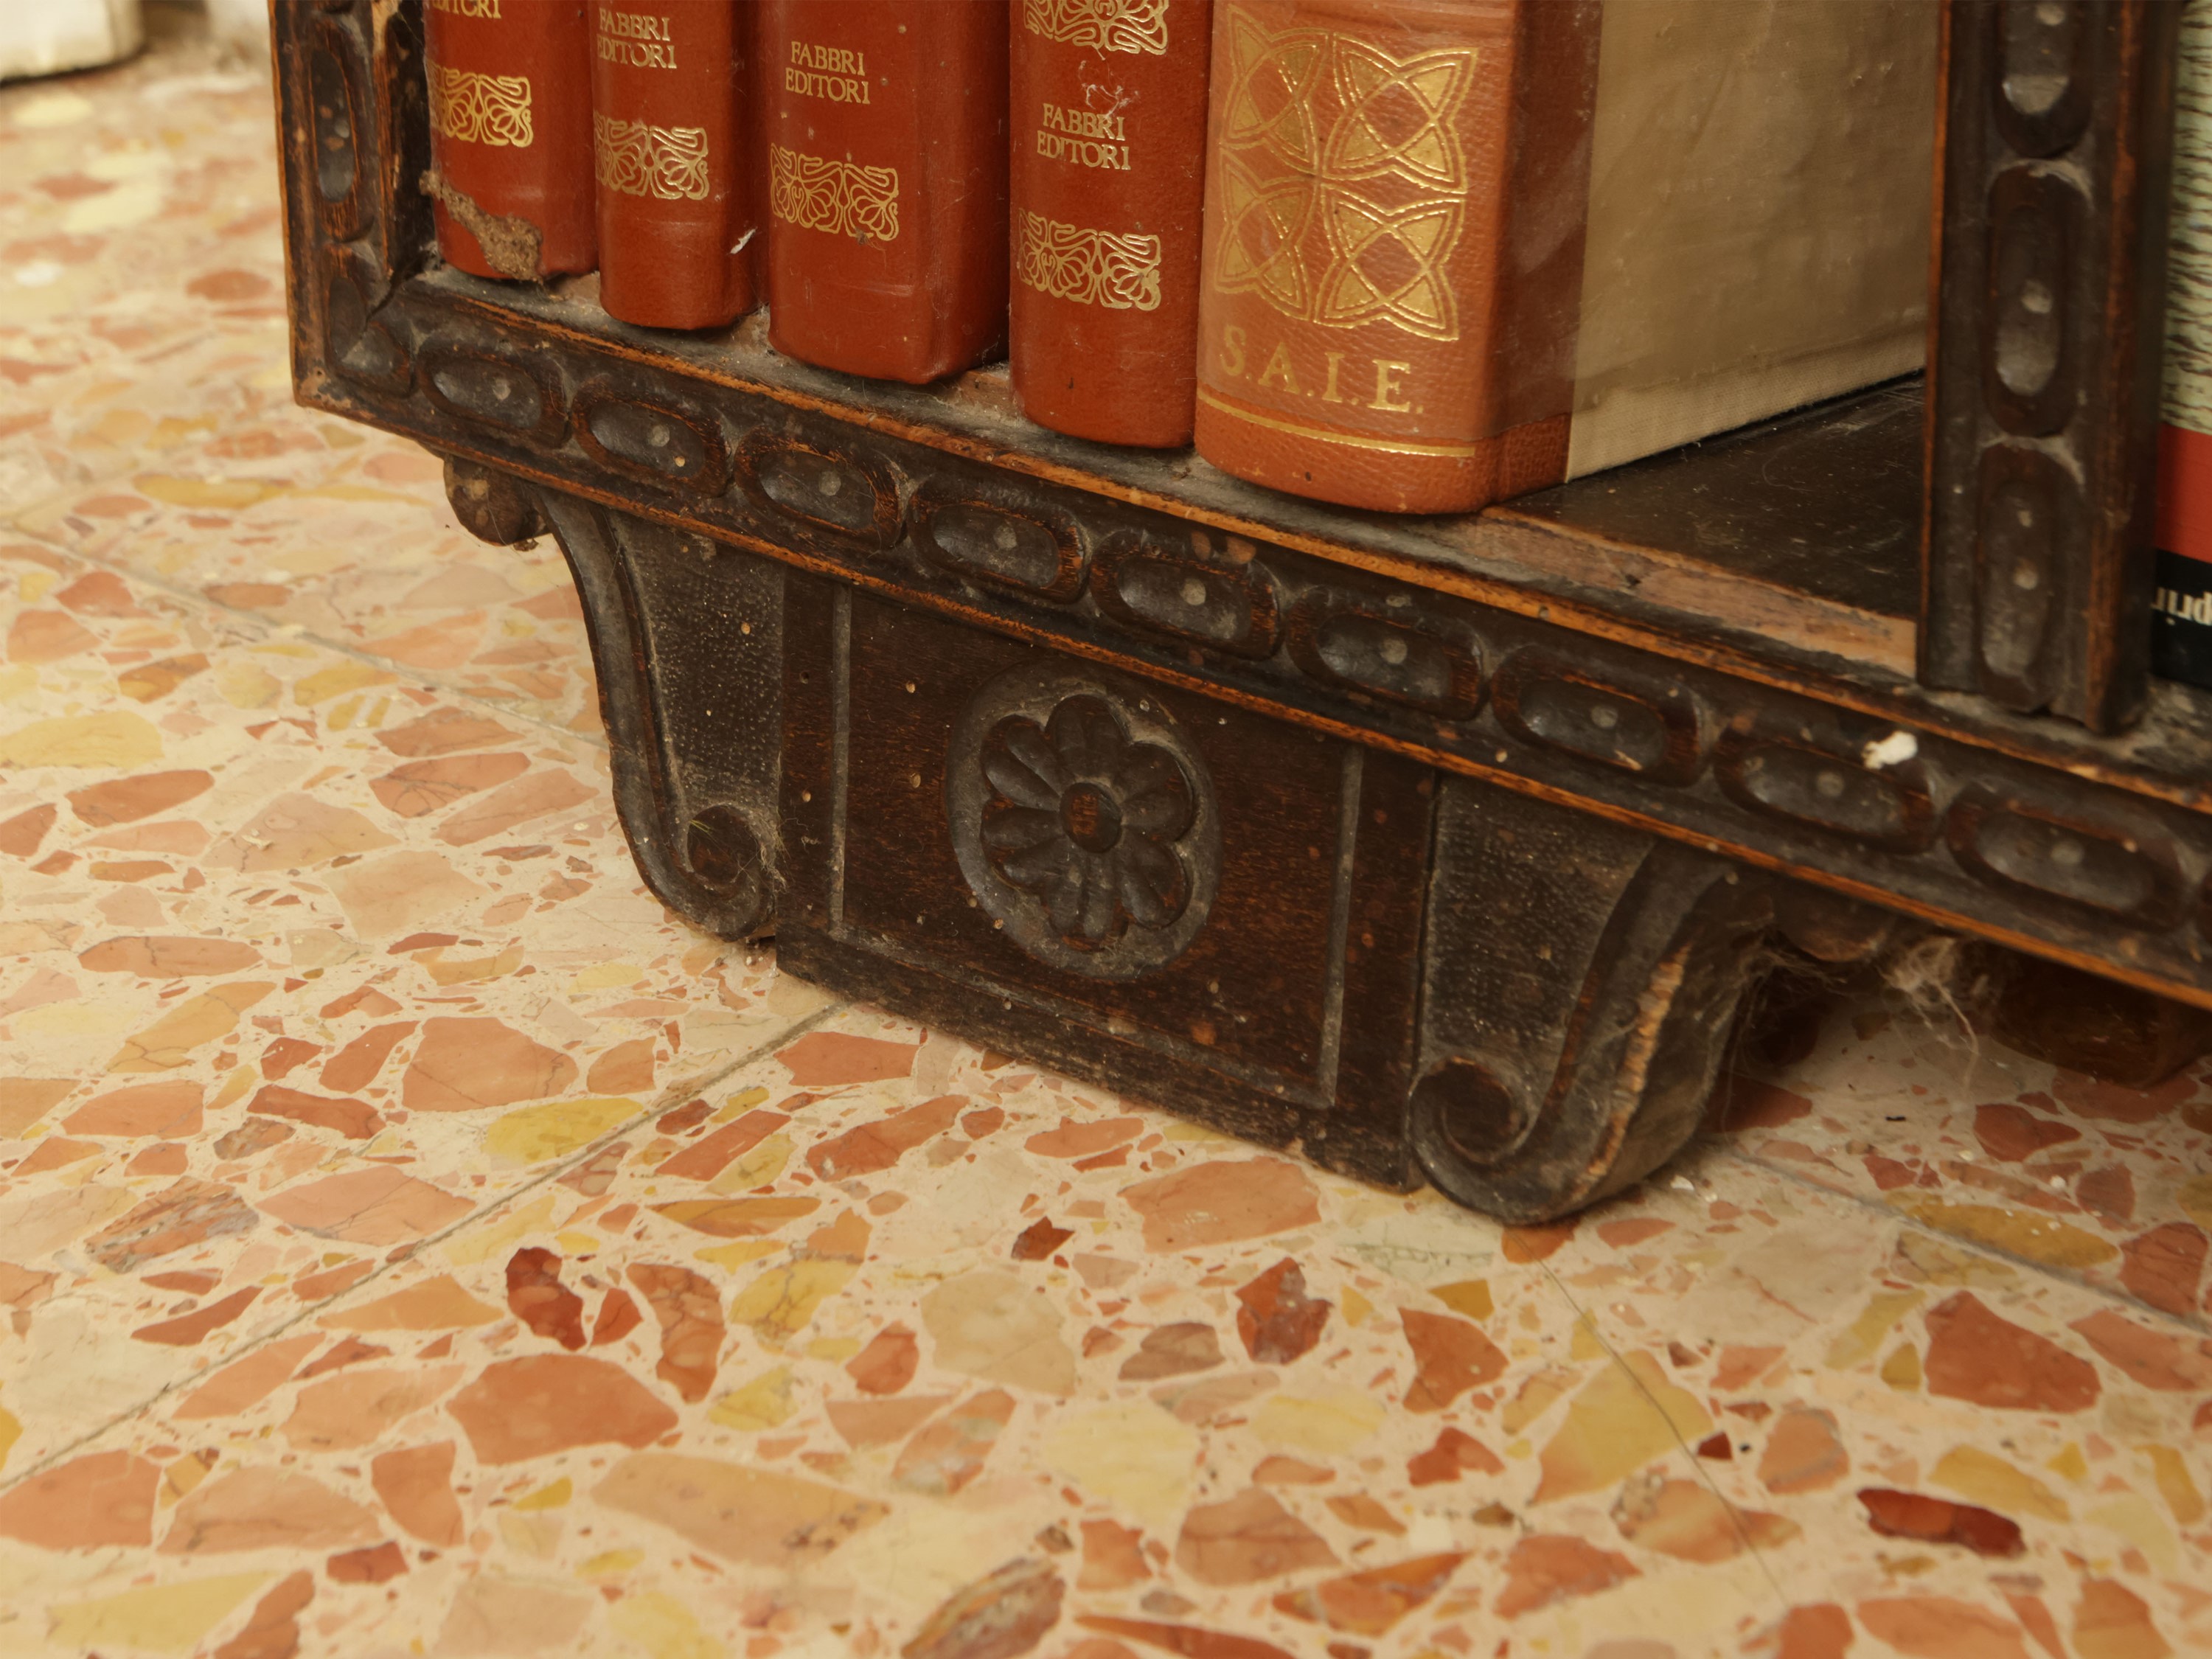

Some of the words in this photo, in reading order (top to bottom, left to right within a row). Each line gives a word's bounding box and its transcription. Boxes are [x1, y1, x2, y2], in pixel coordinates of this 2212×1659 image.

[599, 7, 671, 42] FABBRI
[596, 33, 677, 69] EDITORI
[790, 41, 866, 77] FABBRI
[785, 67, 871, 105] EDITORI
[1043, 102, 1126, 142] FABBRI
[1037, 130, 1132, 170] EDITORI
[1220, 324, 1425, 414] S.A.I.E.
